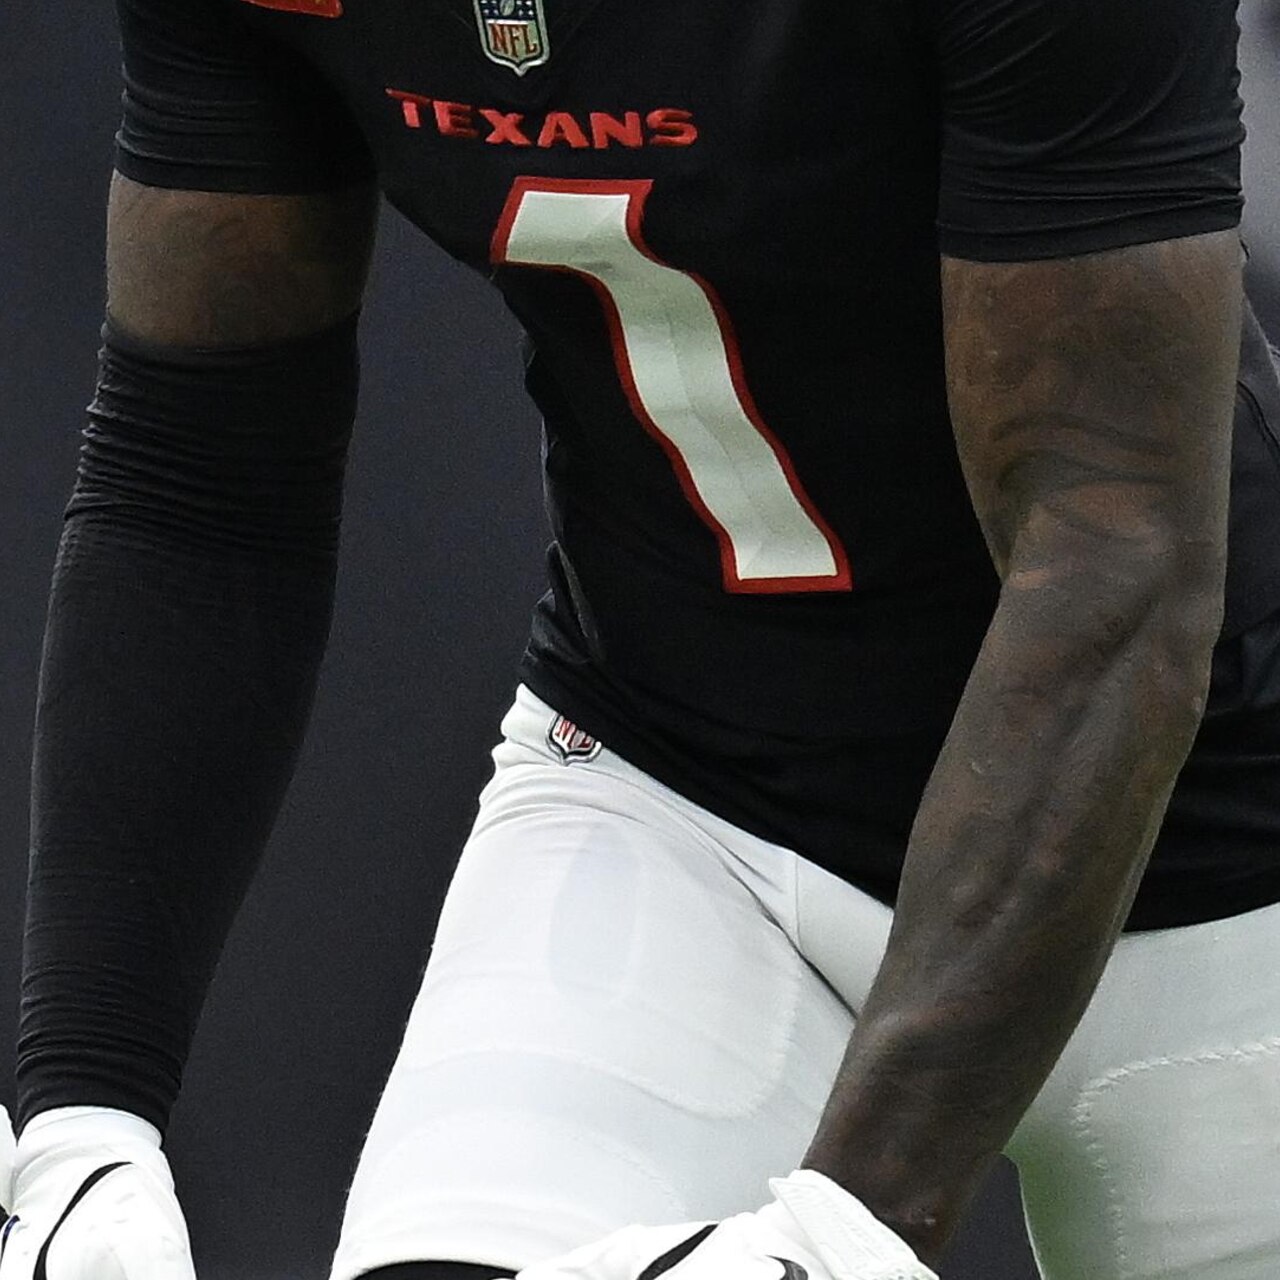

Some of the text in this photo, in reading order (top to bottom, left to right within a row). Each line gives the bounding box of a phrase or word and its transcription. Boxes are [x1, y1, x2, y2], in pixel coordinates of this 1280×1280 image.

[489, 22, 538, 59] NFL
[385, 87, 699, 150] TEXANS
[489, 176, 853, 593] 1
